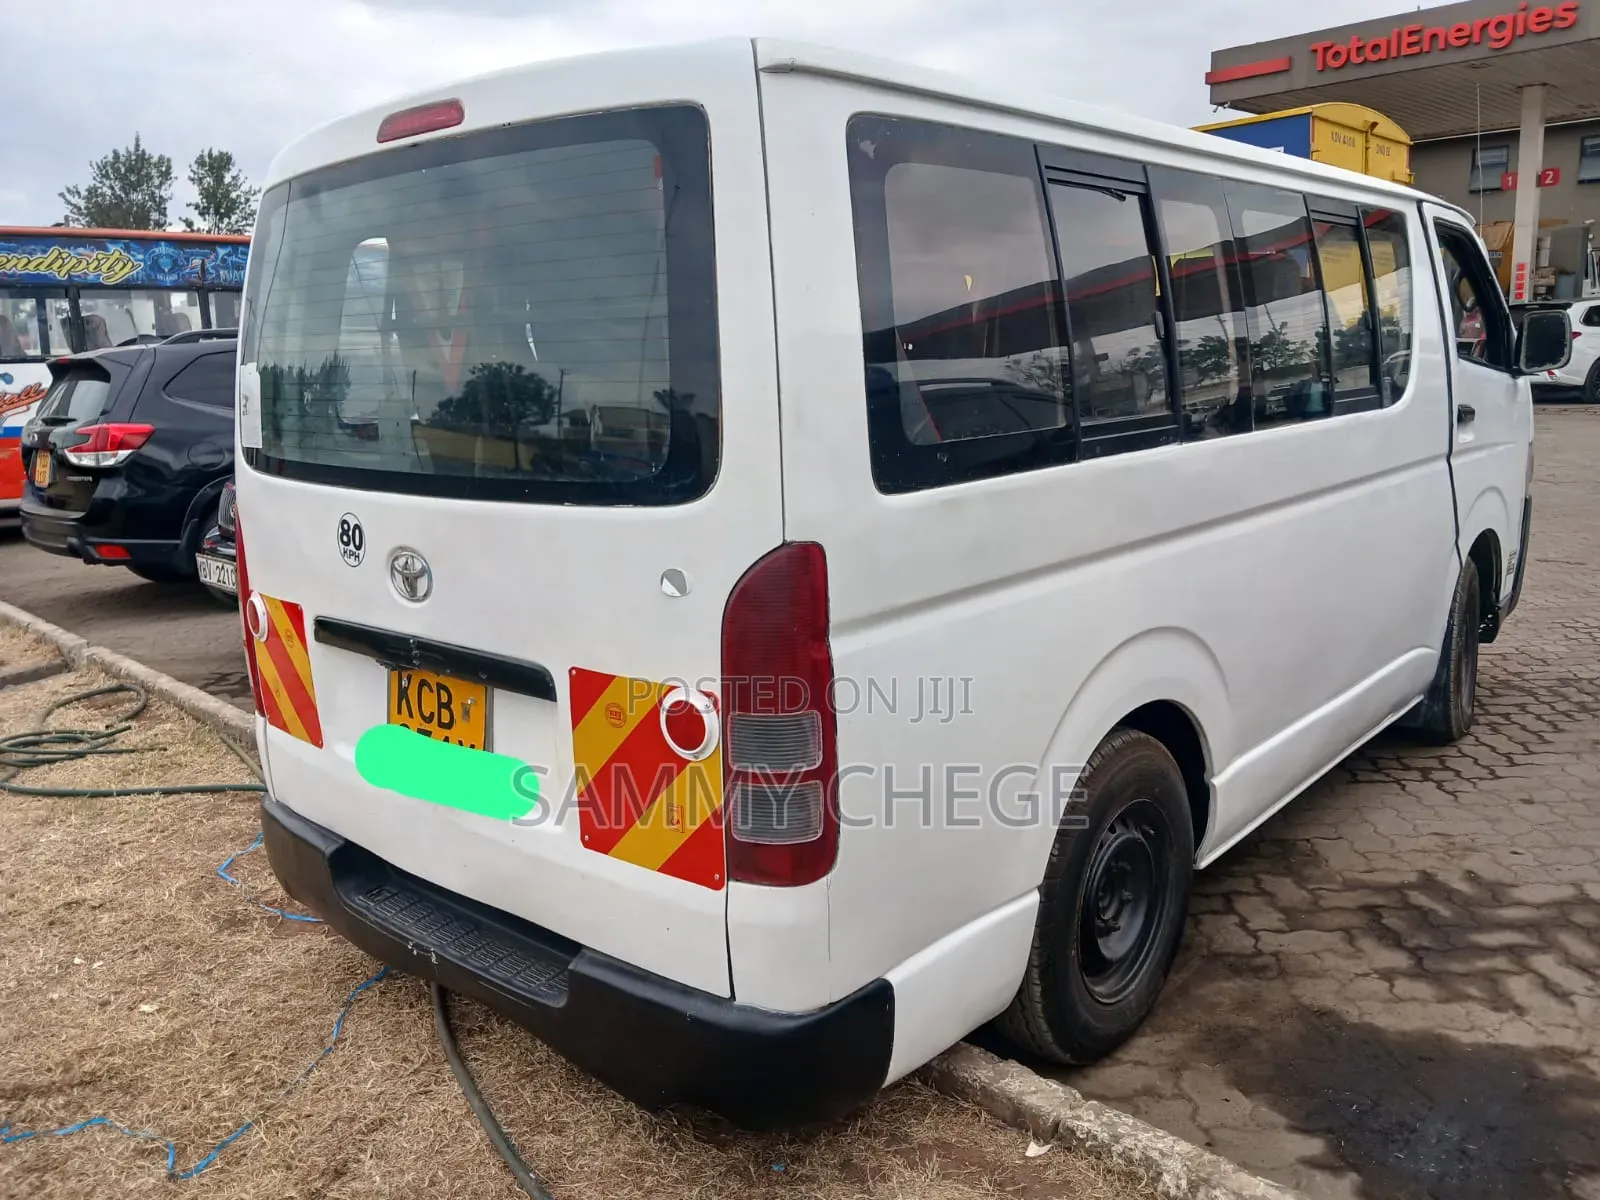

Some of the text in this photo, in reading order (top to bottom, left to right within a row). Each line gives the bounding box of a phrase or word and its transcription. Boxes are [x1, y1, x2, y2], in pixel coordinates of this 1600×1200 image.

[1310, 1, 1579, 71] TotalEnergies
[1507, 176, 1513, 187] 1
[1544, 170, 1555, 184] 2
[340, 519, 363, 551] 80
[343, 547, 360, 562] KPH
[396, 671, 456, 730] KCB
